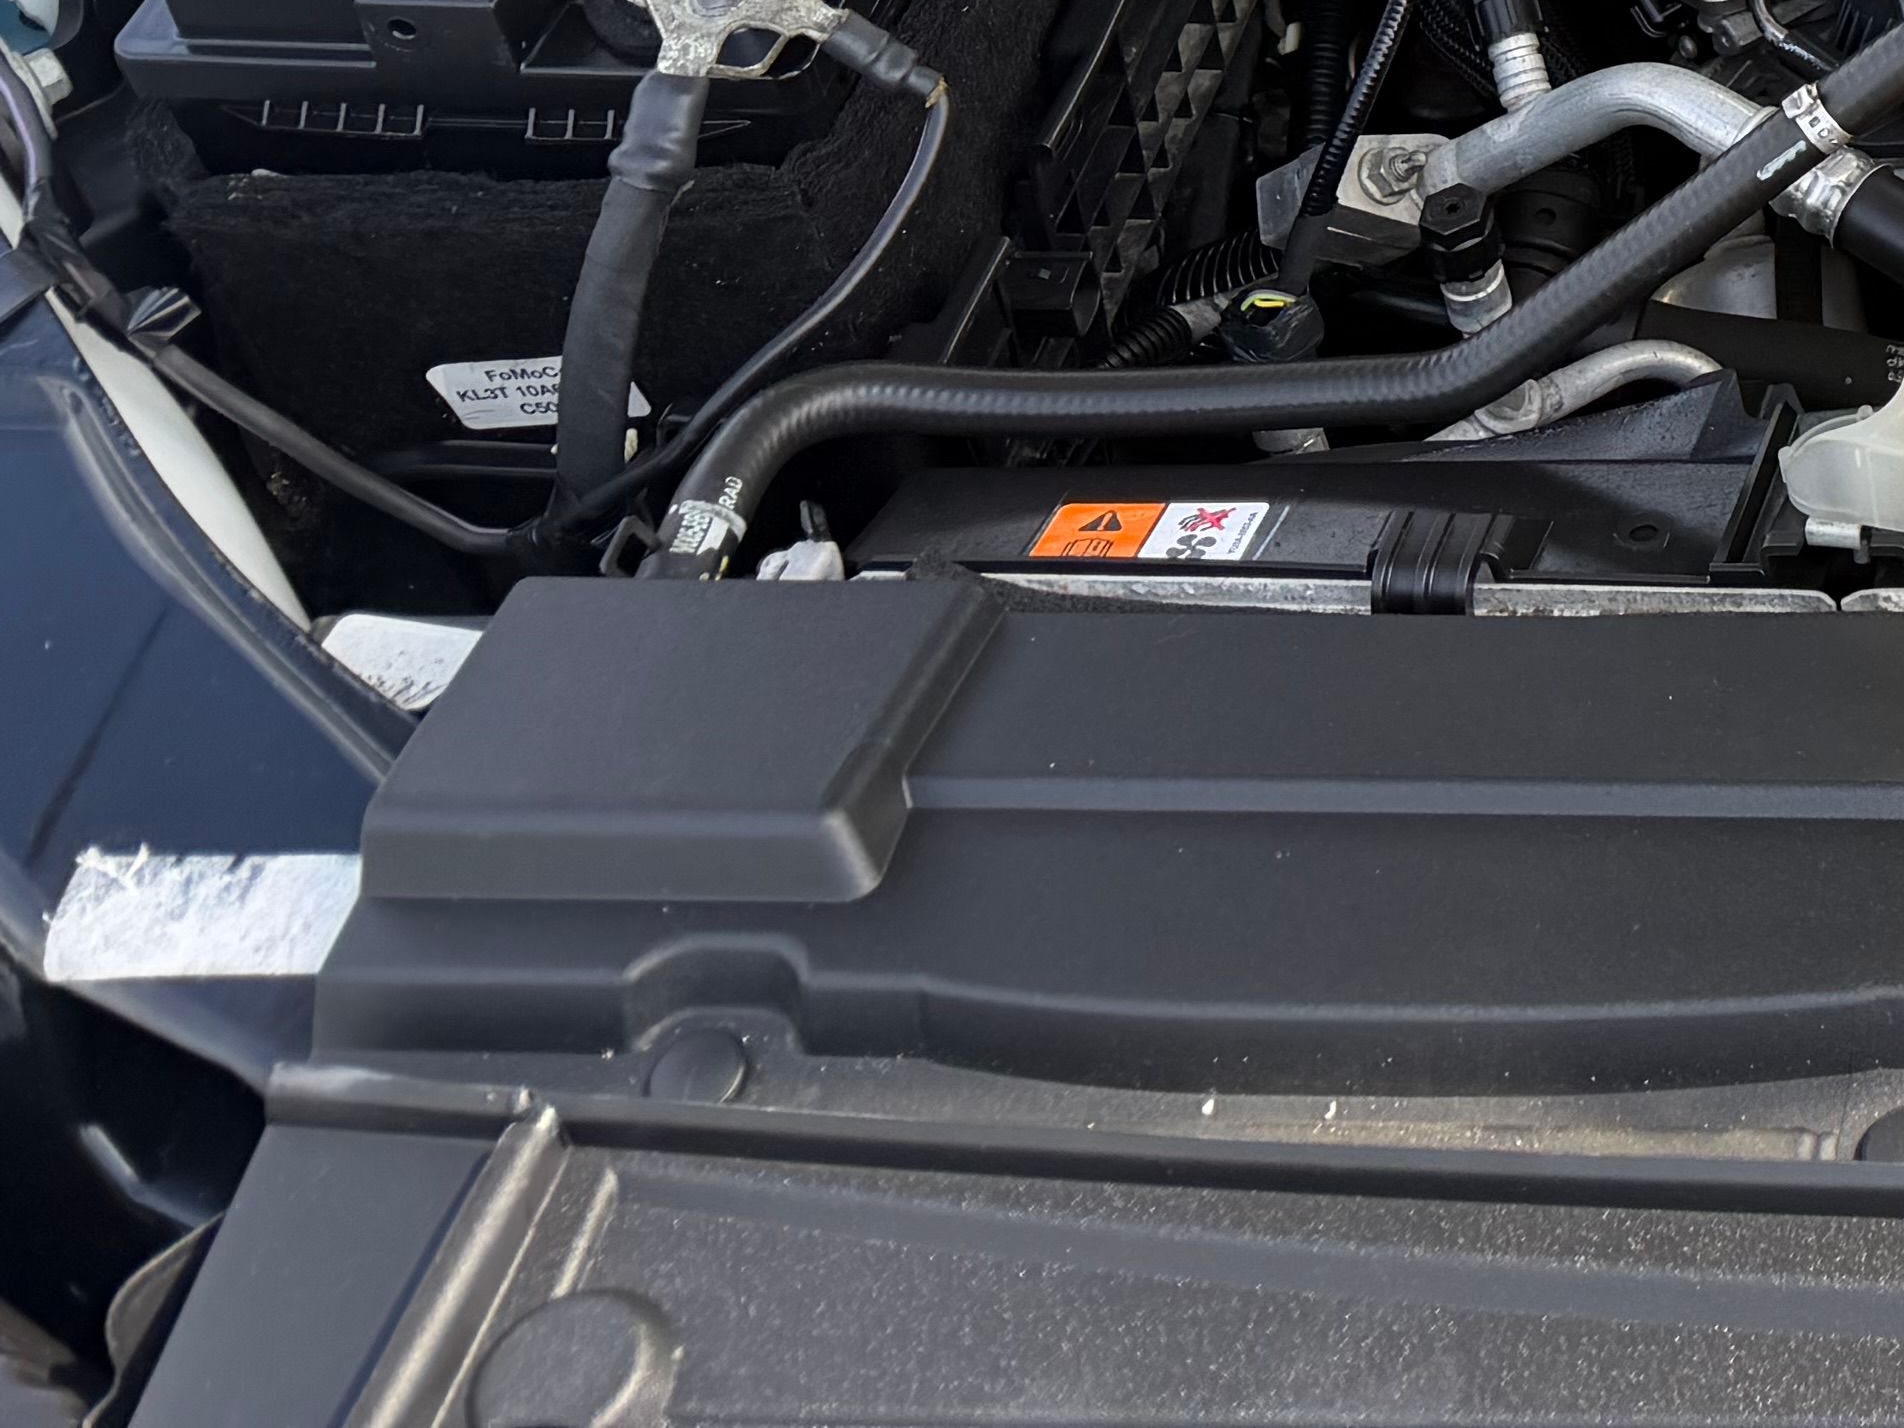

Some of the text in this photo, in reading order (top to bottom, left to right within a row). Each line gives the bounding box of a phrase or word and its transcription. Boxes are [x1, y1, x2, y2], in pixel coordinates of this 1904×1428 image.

[484, 365, 563, 383] FoMoC
[456, 384, 511, 403] KL3T
[718, 476, 742, 510] RAD
